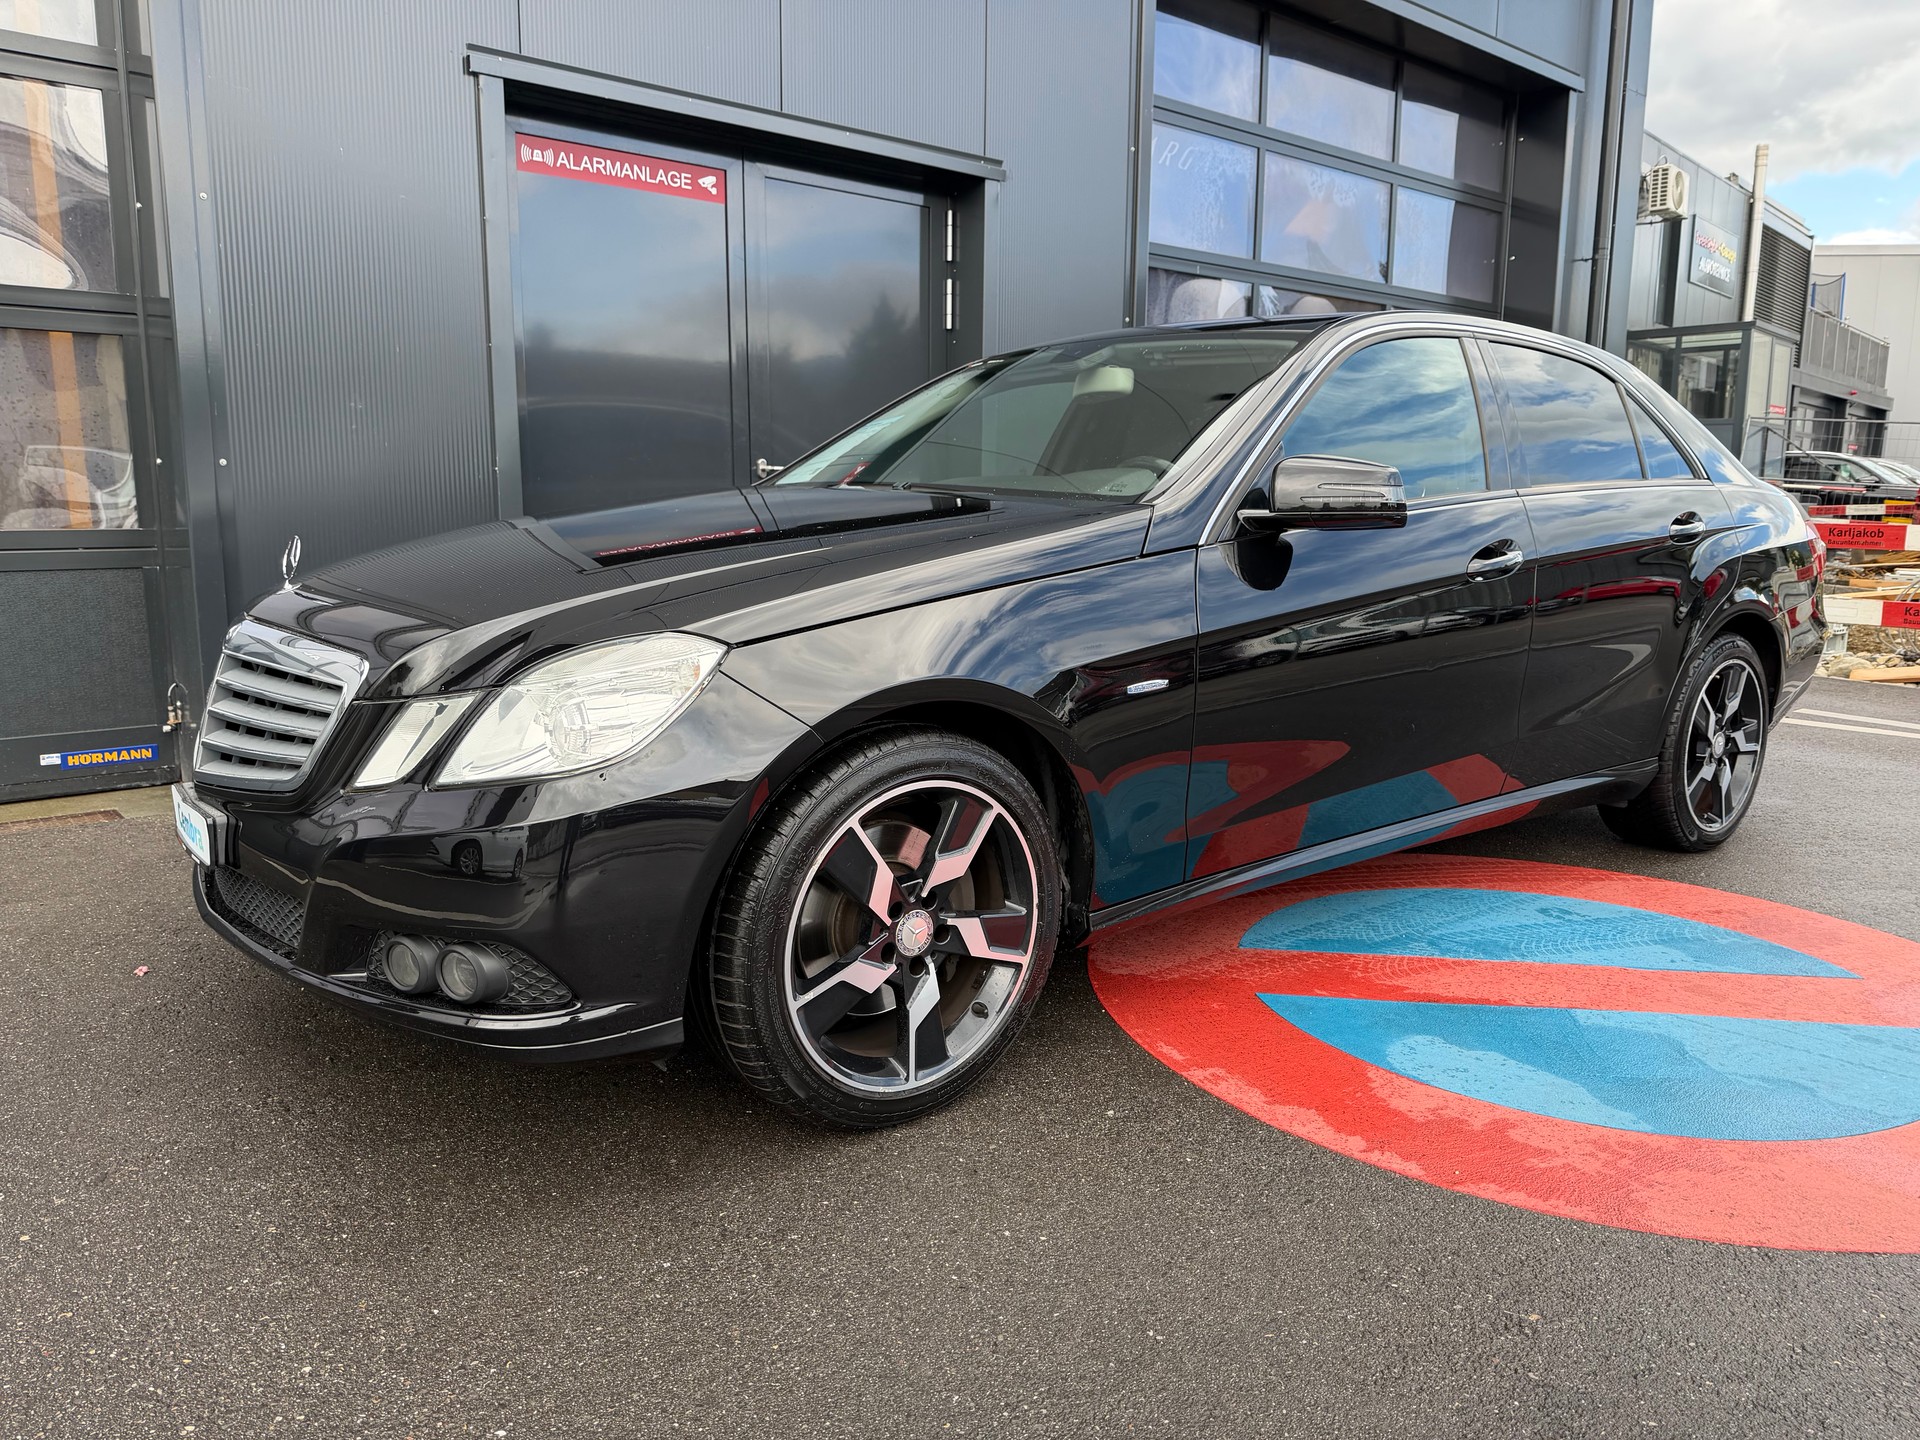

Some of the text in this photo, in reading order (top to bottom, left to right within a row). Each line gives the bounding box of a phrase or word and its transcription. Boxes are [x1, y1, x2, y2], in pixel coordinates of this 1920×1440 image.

[556, 151, 693, 190] ALARMANLAGE
[1828, 527, 1885, 540] Karljakob
[67, 747, 153, 767] HÖRMANN
